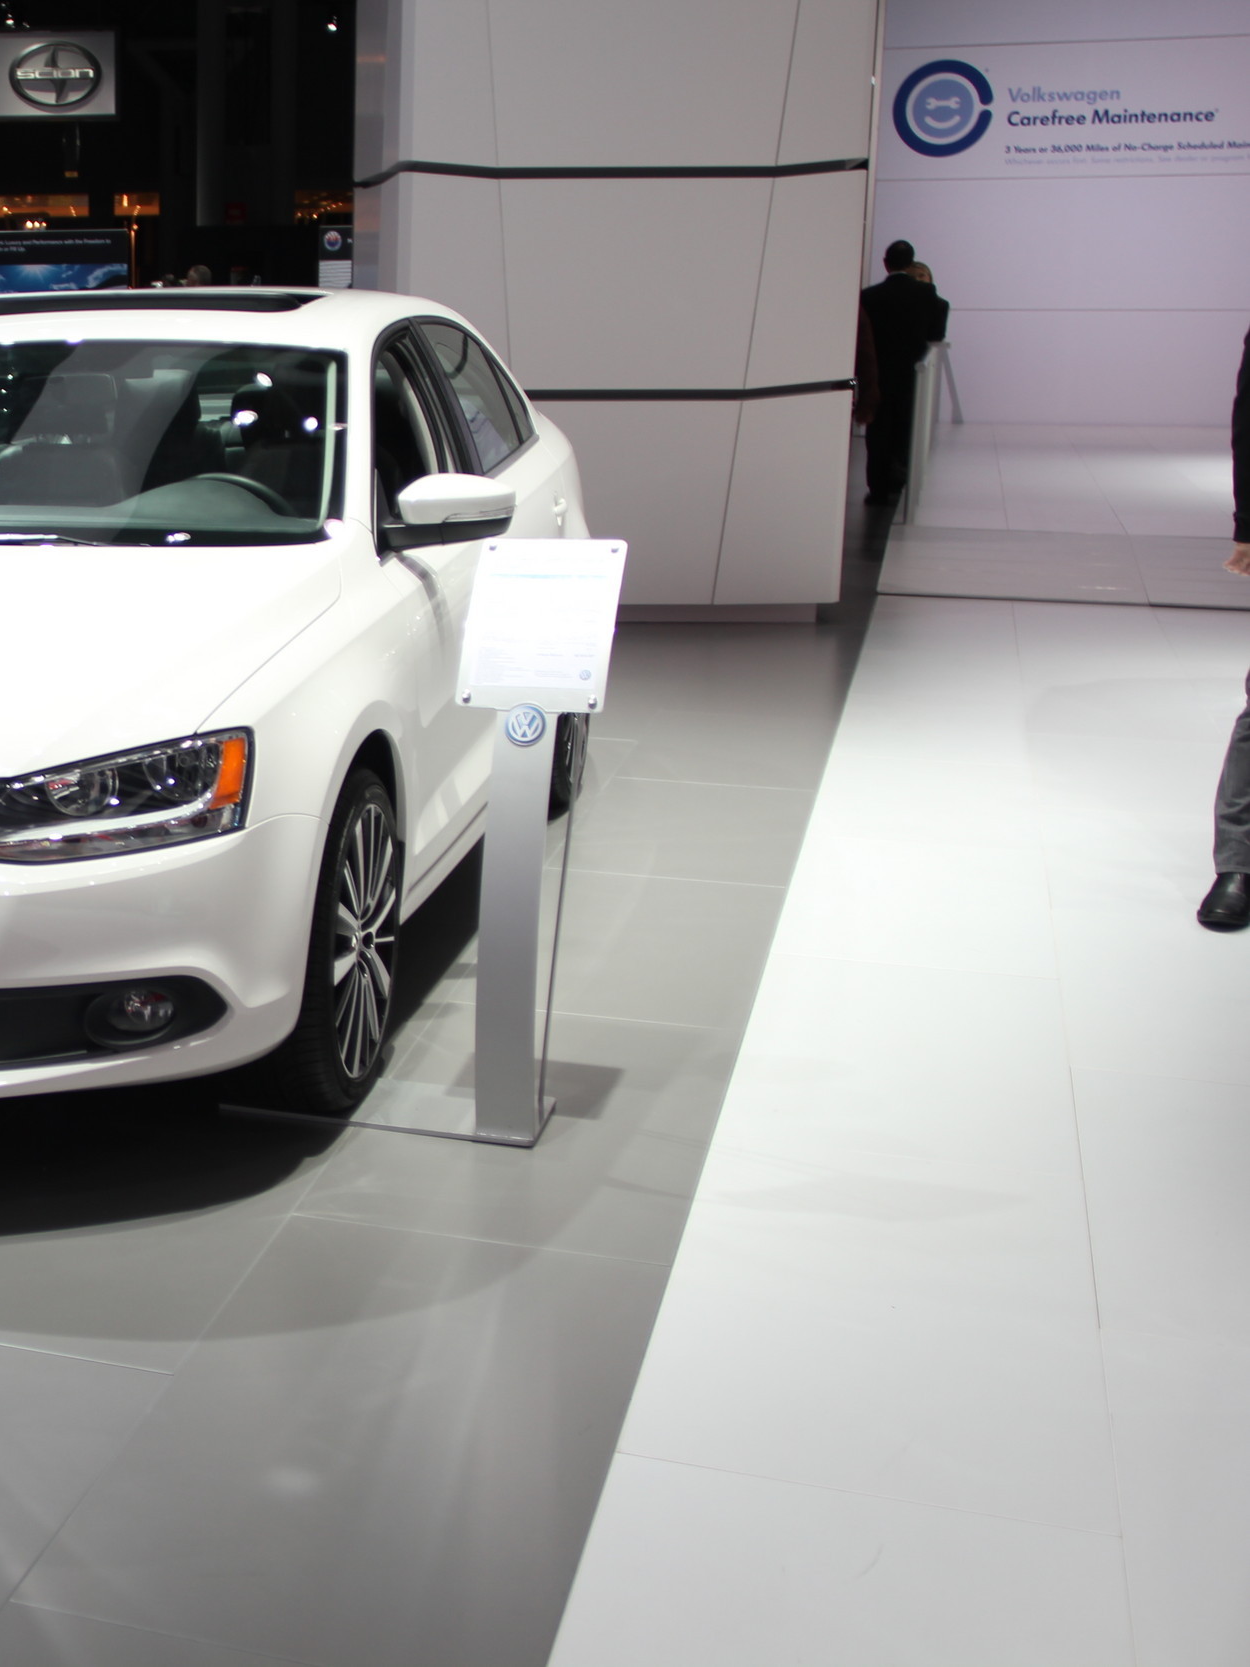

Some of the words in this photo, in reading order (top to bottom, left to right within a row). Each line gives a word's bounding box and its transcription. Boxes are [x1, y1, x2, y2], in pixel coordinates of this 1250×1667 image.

[1008, 86, 1121, 105] Volkswagen
[1007, 109, 1087, 126] Carefree
[1091, 108, 1216, 125] Maintenance
[1005, 145, 1011, 154] 3
[1013, 145, 1037, 154] Years
[1038, 146, 1048, 154] or
[1085, 144, 1109, 153] Miles
[1111, 143, 1122, 152] of
[1177, 141, 1224, 151] Scheduled
